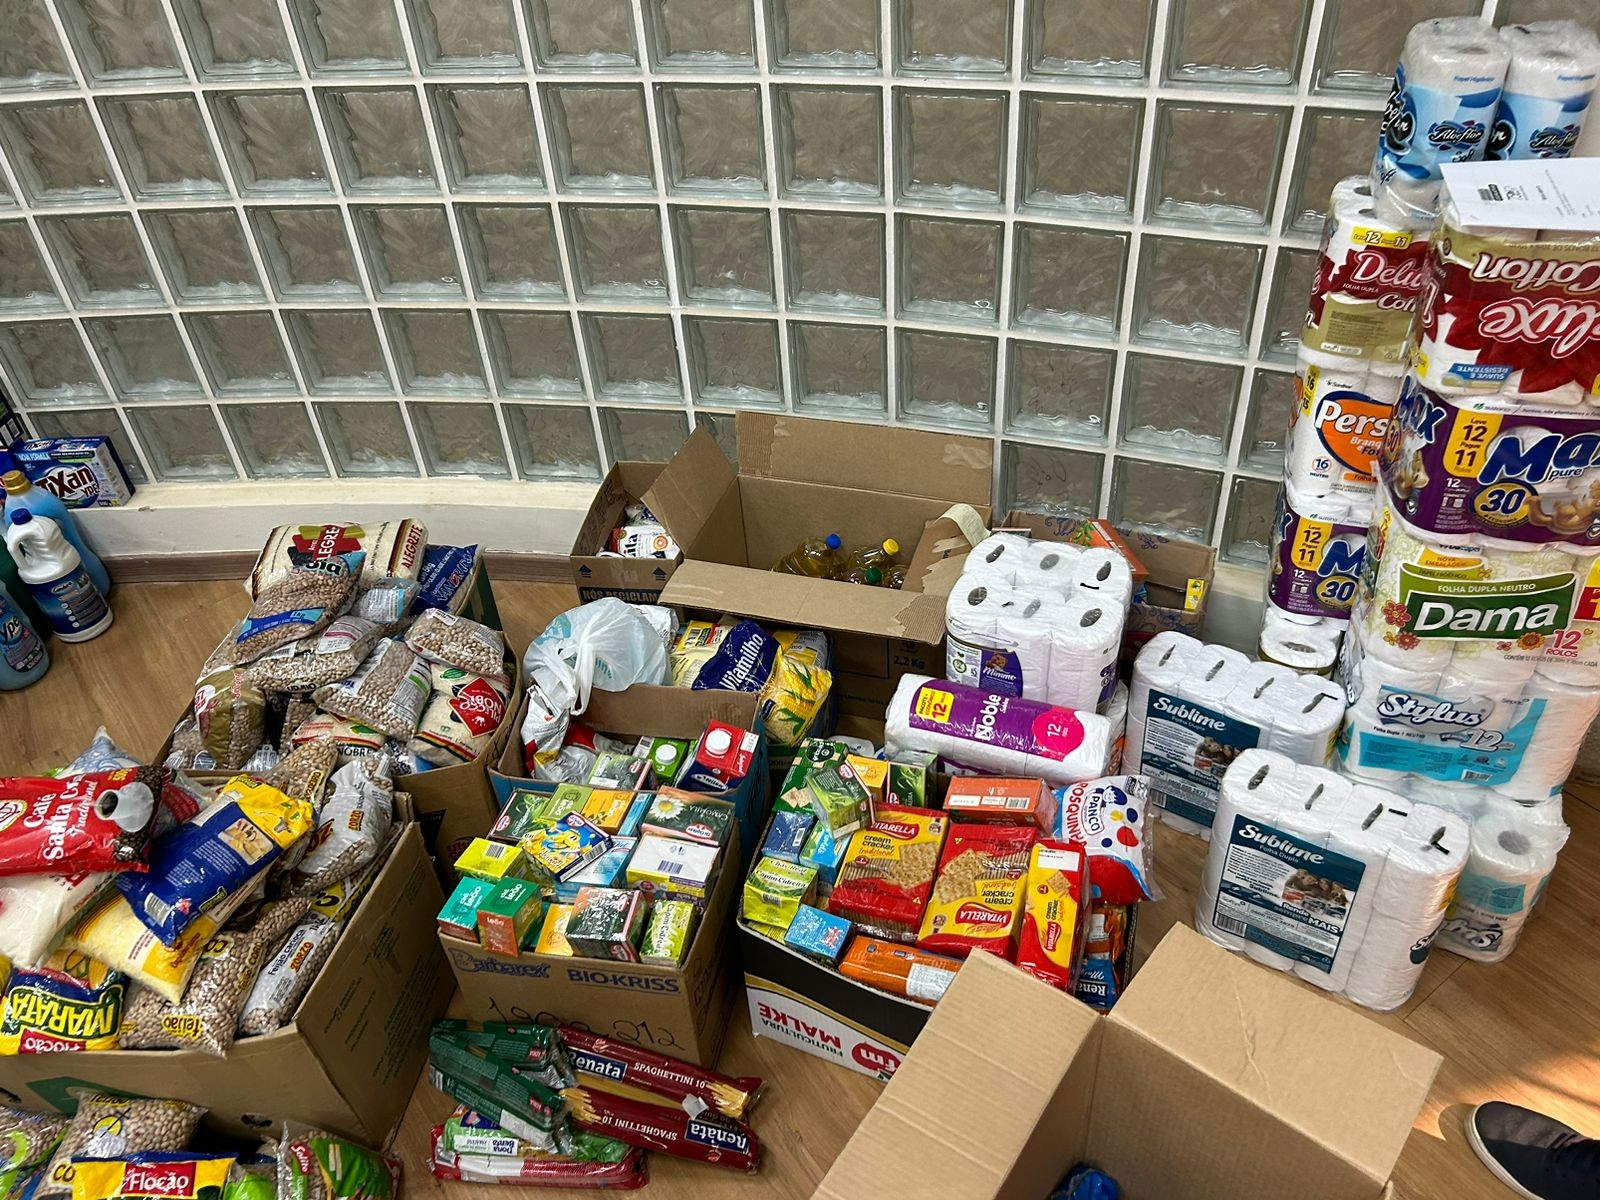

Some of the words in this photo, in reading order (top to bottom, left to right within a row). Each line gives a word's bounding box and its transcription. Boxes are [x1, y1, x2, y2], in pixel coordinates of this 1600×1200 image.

[1366, 231, 1381, 244] 12
[1395, 236, 1407, 247] 11
[1351, 250, 1422, 290] Delu
[1315, 399, 1389, 438] Pers
[1463, 424, 1488, 442] 12
[1314, 459, 1330, 470] 16
[1455, 450, 1477, 467] 11
[1446, 478, 1460, 488] 12
[1550, 468, 1583, 481] pure
[1480, 488, 1526, 516] 30
[316, 526, 341, 566] LEGRE
[401, 523, 425, 569] ALEGRETE
[1303, 529, 1322, 544] 12
[1298, 548, 1316, 563] 11
[1293, 569, 1305, 579] 12
[1321, 580, 1356, 602] 30
[1437, 584, 1466, 593] FOLHA
[1500, 583, 1537, 593] NEUTRO
[1413, 601, 1559, 632] Dama
[1552, 629, 1582, 650] 12
[719, 633, 765, 691] Vitamilho
[1546, 649, 1579, 658] ROLOS
[932, 704, 947, 719] 12
[974, 693, 1001, 742] Noble
[1153, 697, 1226, 731] Sublime
[1377, 693, 1483, 726] Stylus
[1047, 723, 1062, 737] 12
[1460, 728, 1504, 752] 12
[23, 793, 57, 828] Café
[66, 780, 98, 838] Tradicional
[1086, 795, 1101, 832] PANCO
[43, 802, 74, 860] Santa
[870, 821, 916, 836] VITARELLA
[862, 841, 895, 850] cracker
[864, 835, 892, 844] cream
[1238, 824, 1324, 864] Sublime
[1259, 845, 1278, 856] Folha
[1278, 851, 1299, 863] Dupla
[755, 870, 779, 881] Capim
[778, 876, 807, 888] Cidreira
[981, 890, 1015, 898] cracker
[984, 897, 1013, 905] cream
[959, 911, 1008, 924] VITARELLA
[1283, 902, 1310, 917] Rende
[1047, 922, 1057, 951] VITARELLA
[289, 941, 314, 972] ZORZO
[1078, 984, 1106, 997] Rena
[757, 1002, 842, 1050] MALKE
[760, 1017, 844, 1058] FRUTICULTURA
[633, 1062, 694, 1086] SPAGHETTINI
[694, 1080, 706, 1089] 10
[602, 1115, 614, 1124] 10
[614, 1118, 679, 1141] SPAGHETTINI
[690, 1122, 748, 1150] Renata
[492, 1139, 515, 1147] Benta
[493, 1146, 514, 1154] Dona
[291, 1144, 309, 1173] Solito
[129, 1172, 190, 1191] Flocão
